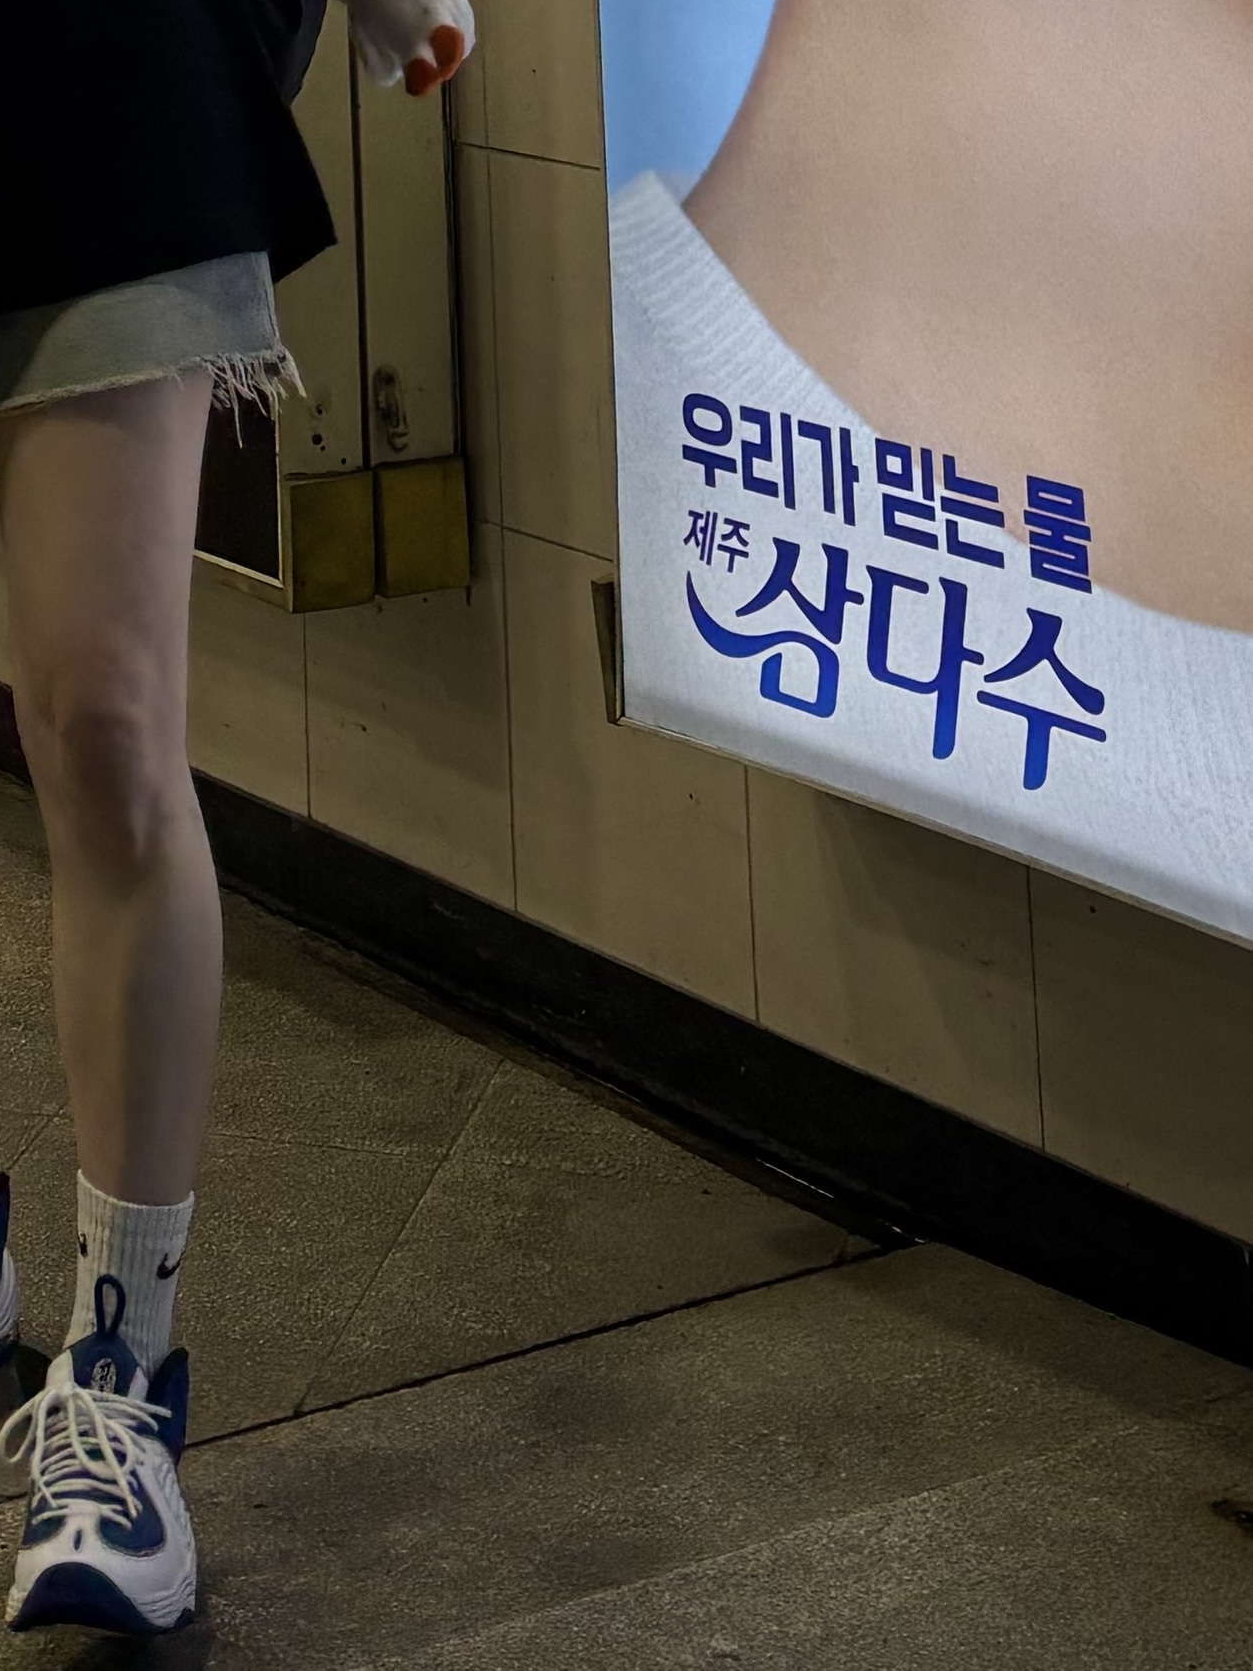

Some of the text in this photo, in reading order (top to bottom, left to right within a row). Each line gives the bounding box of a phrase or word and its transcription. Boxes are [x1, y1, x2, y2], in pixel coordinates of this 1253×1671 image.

[680, 391, 1093, 594] 우리가 믿는 물
[682, 508, 751, 574] 제주
[685, 535, 1108, 791] 삼다수
